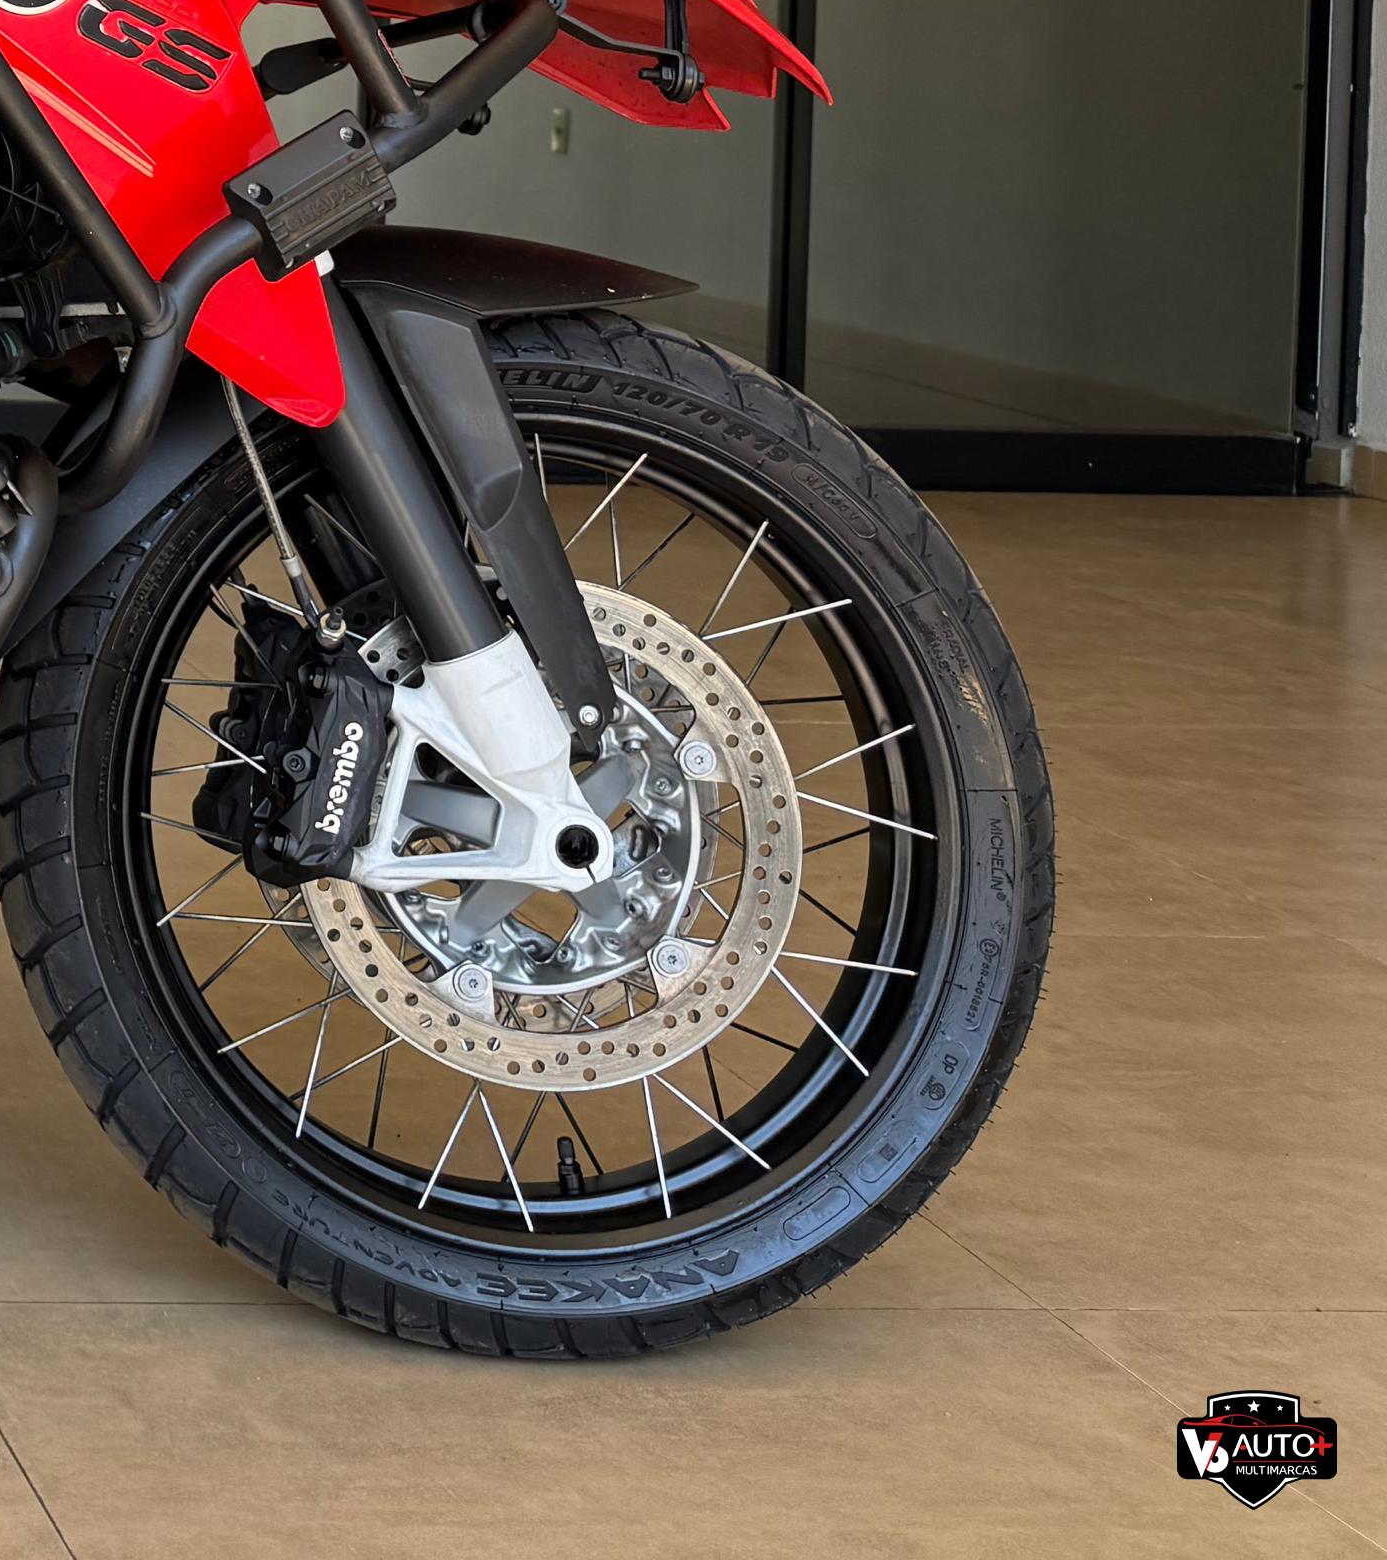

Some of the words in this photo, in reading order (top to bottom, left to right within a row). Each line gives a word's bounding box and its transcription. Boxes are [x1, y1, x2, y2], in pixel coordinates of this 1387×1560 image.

[497, 369, 591, 390] ELIN
[612, 382, 721, 426] 120/70
[315, 722, 364, 835] brembo
[272, 1189, 462, 1288] ADVENTURE
[477, 1248, 740, 1303] ANAKEE
